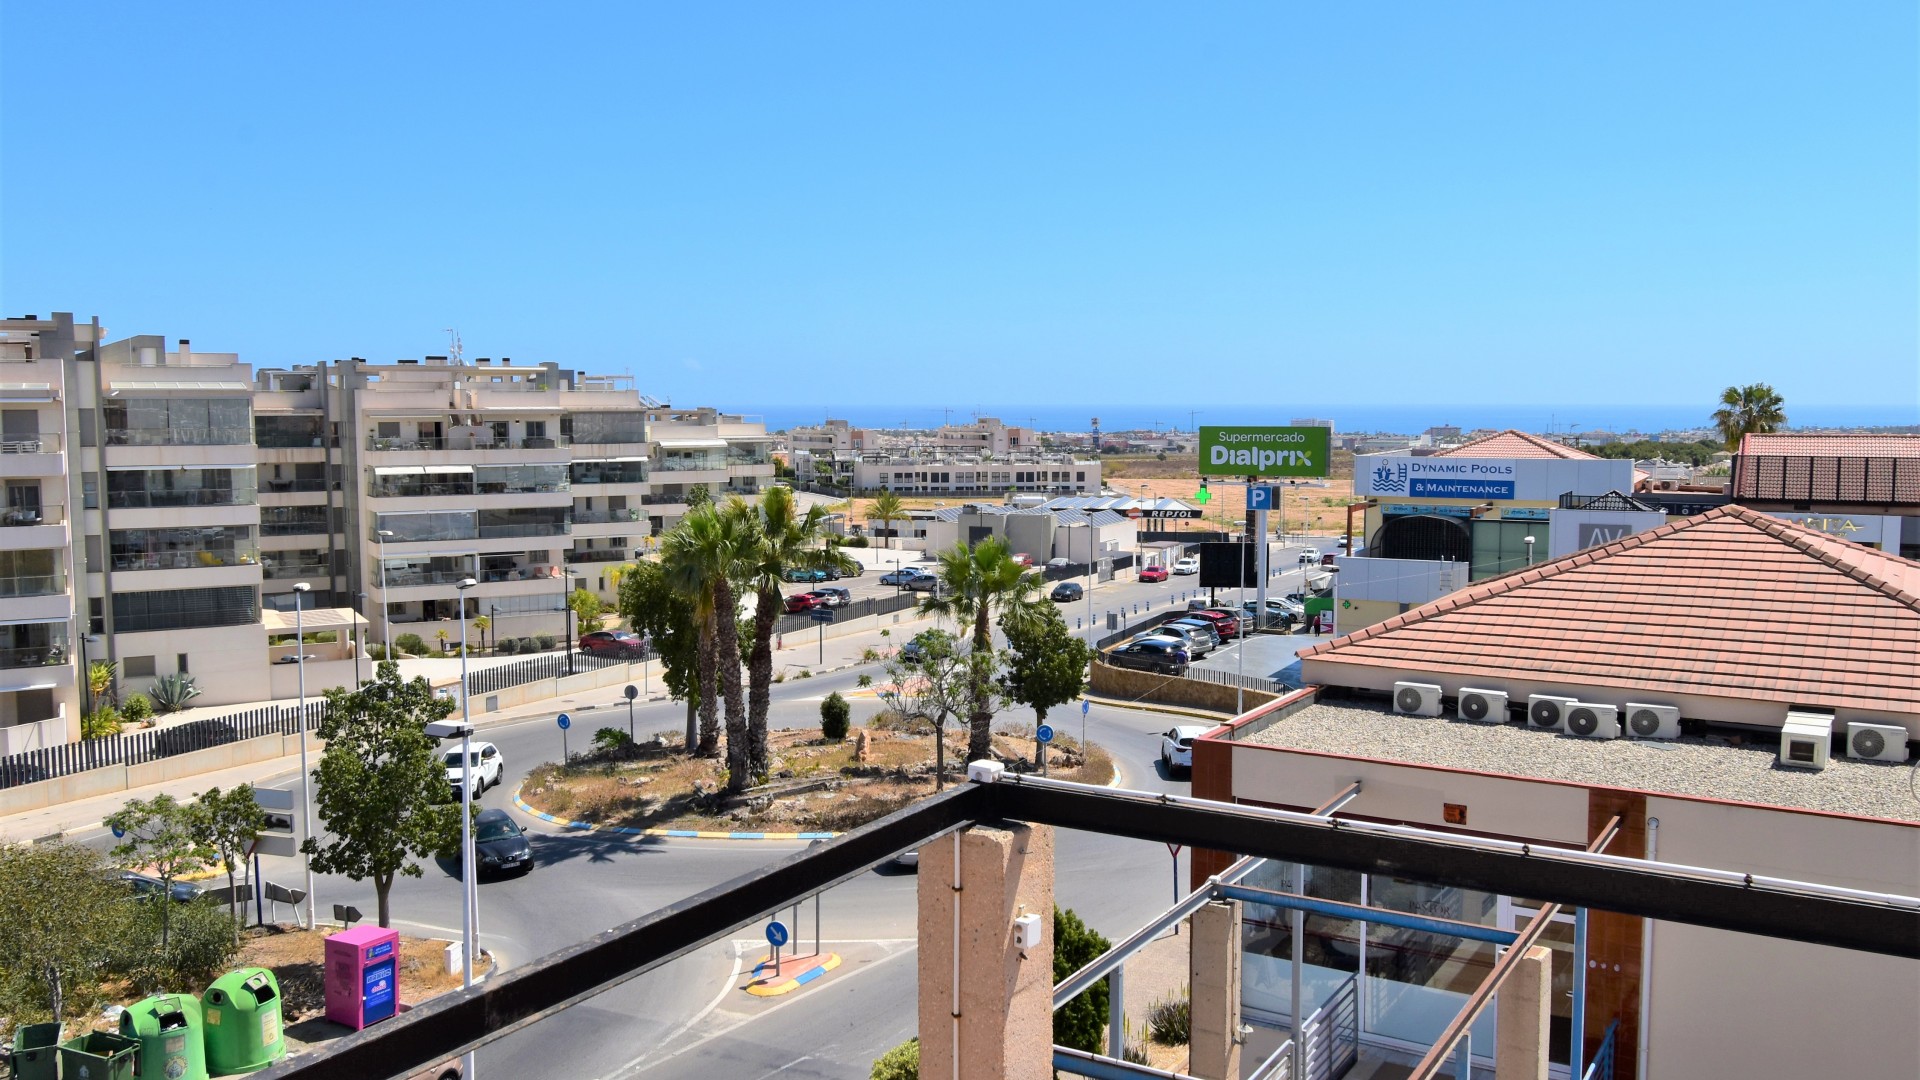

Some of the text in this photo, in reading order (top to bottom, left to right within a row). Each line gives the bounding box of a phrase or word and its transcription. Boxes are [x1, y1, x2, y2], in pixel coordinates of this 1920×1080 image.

[1219, 431, 1305, 444] Supermercado
[1210, 445, 1312, 472] Dialprix
[1411, 462, 1513, 474] DYNAMIC POOLS
[1415, 483, 1508, 494] & MAINTENANCE
[1252, 489, 1266, 507] P
[1151, 510, 1192, 518] REPSOL
